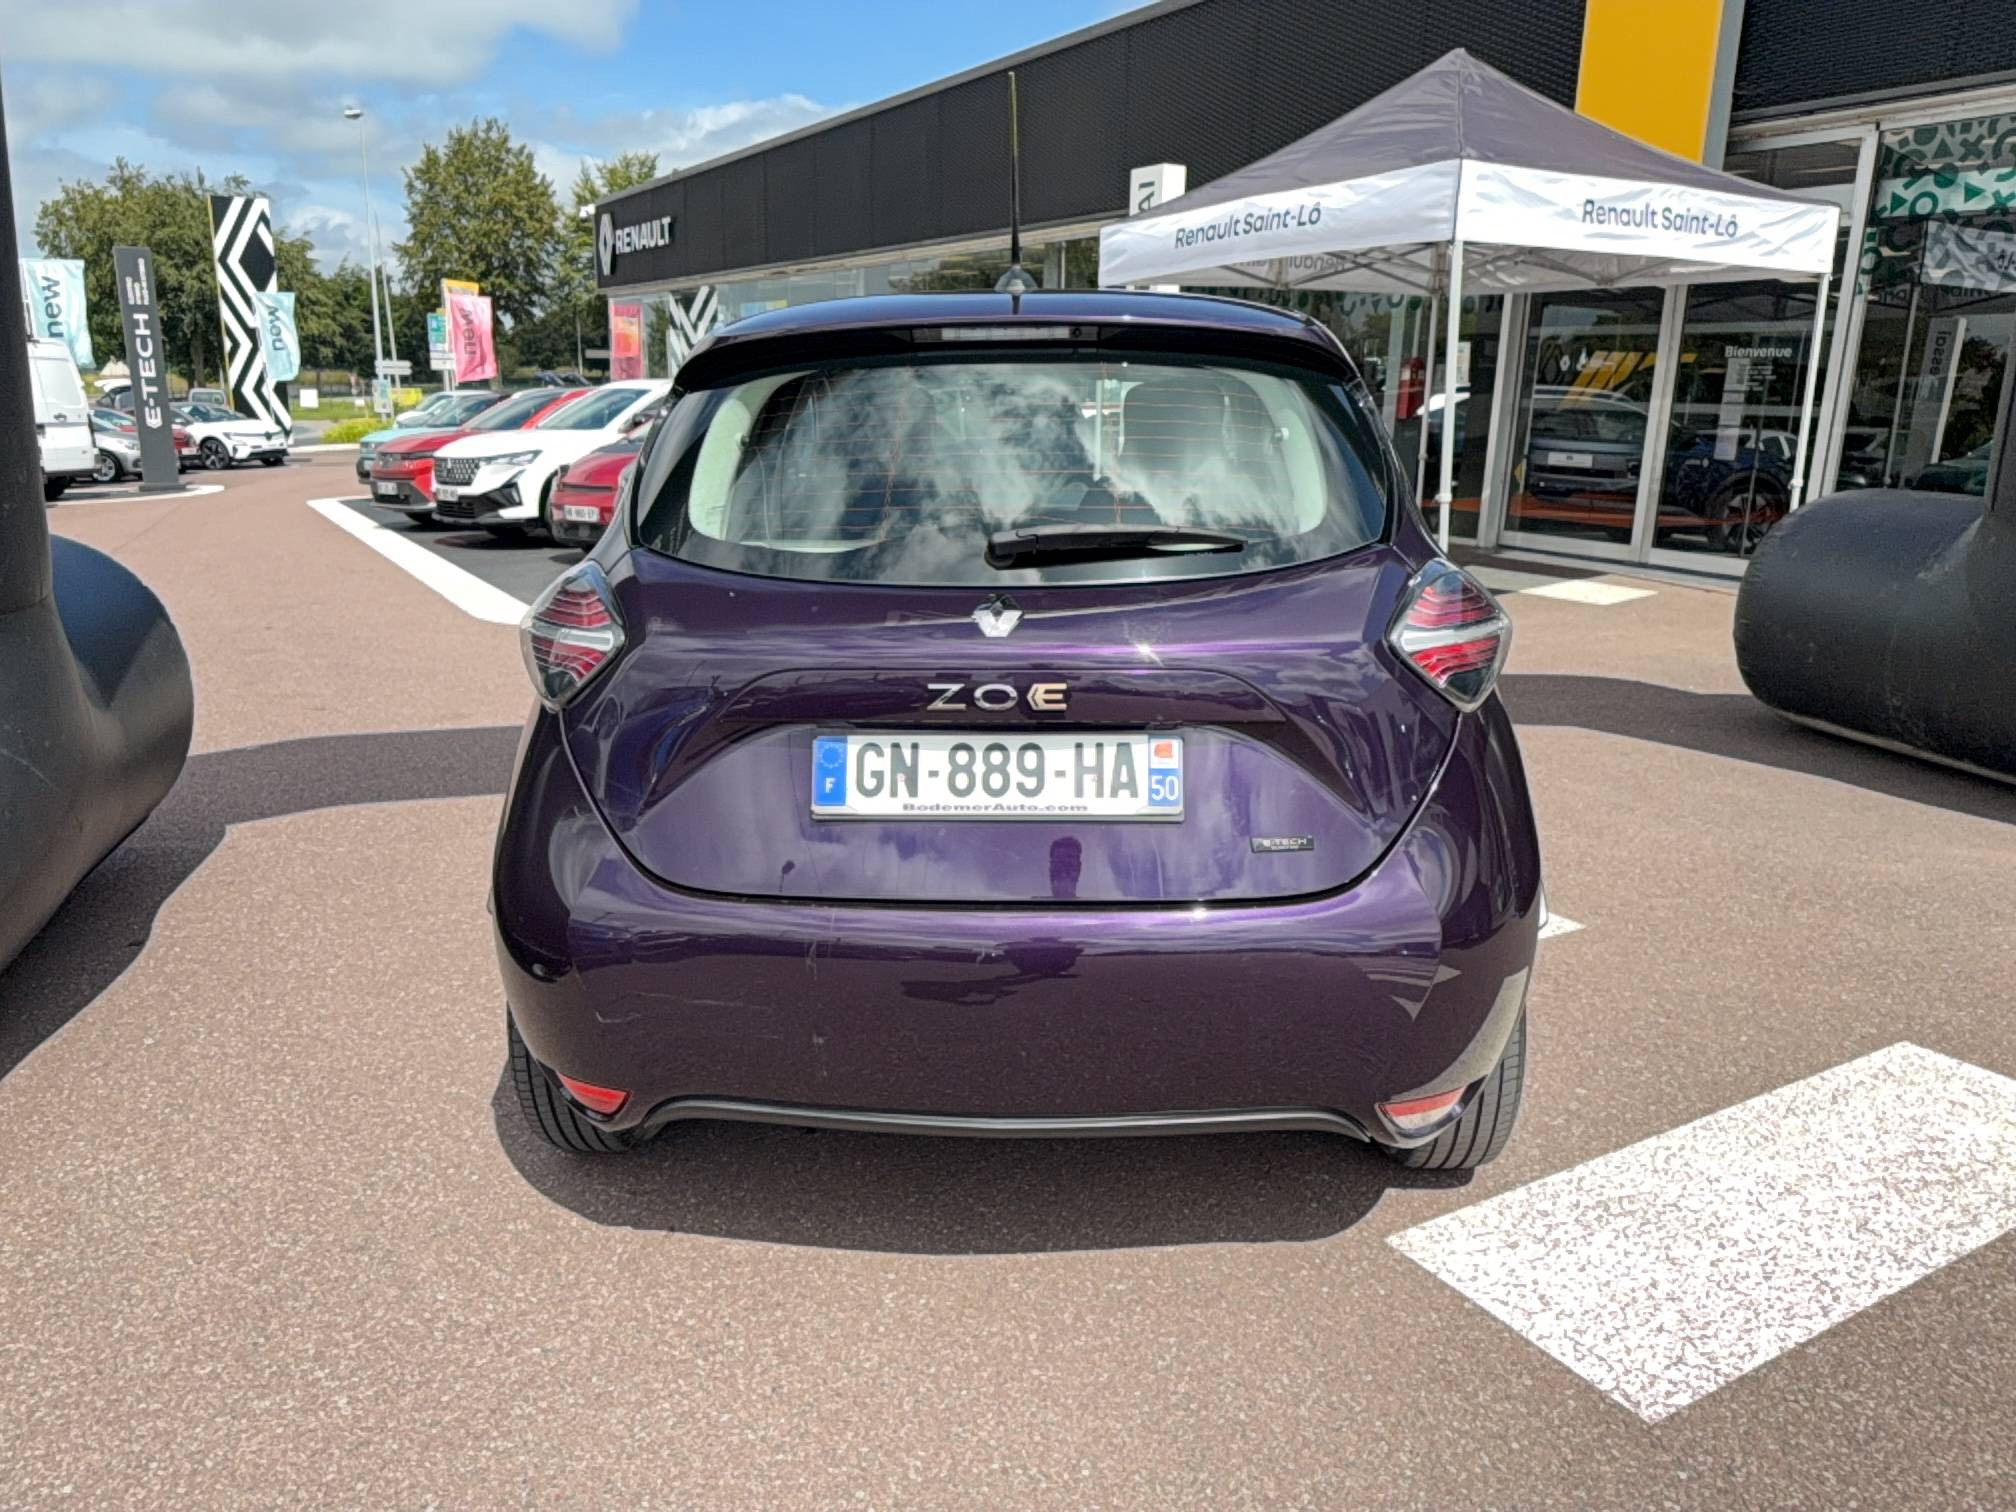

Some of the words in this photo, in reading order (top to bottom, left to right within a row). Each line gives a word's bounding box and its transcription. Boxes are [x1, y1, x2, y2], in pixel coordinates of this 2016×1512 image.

[615, 215, 671, 255] RENAULT
[1174, 215, 1241, 249] Renault
[1242, 201, 1322, 236] Saint-Lô
[1582, 198, 1658, 230] Renault
[1661, 206, 1739, 238] Saint-Lô
[41, 275, 65, 338] new
[132, 313, 163, 429] E-TECH
[1724, 345, 1793, 358] Bienvenue
[926, 682, 1068, 711] ZOE
[824, 778, 836, 793] F
[856, 742, 1139, 798] GN-889-HA
[1151, 776, 1179, 801] 50
[902, 803, 1089, 812] BodemerAuto.com
